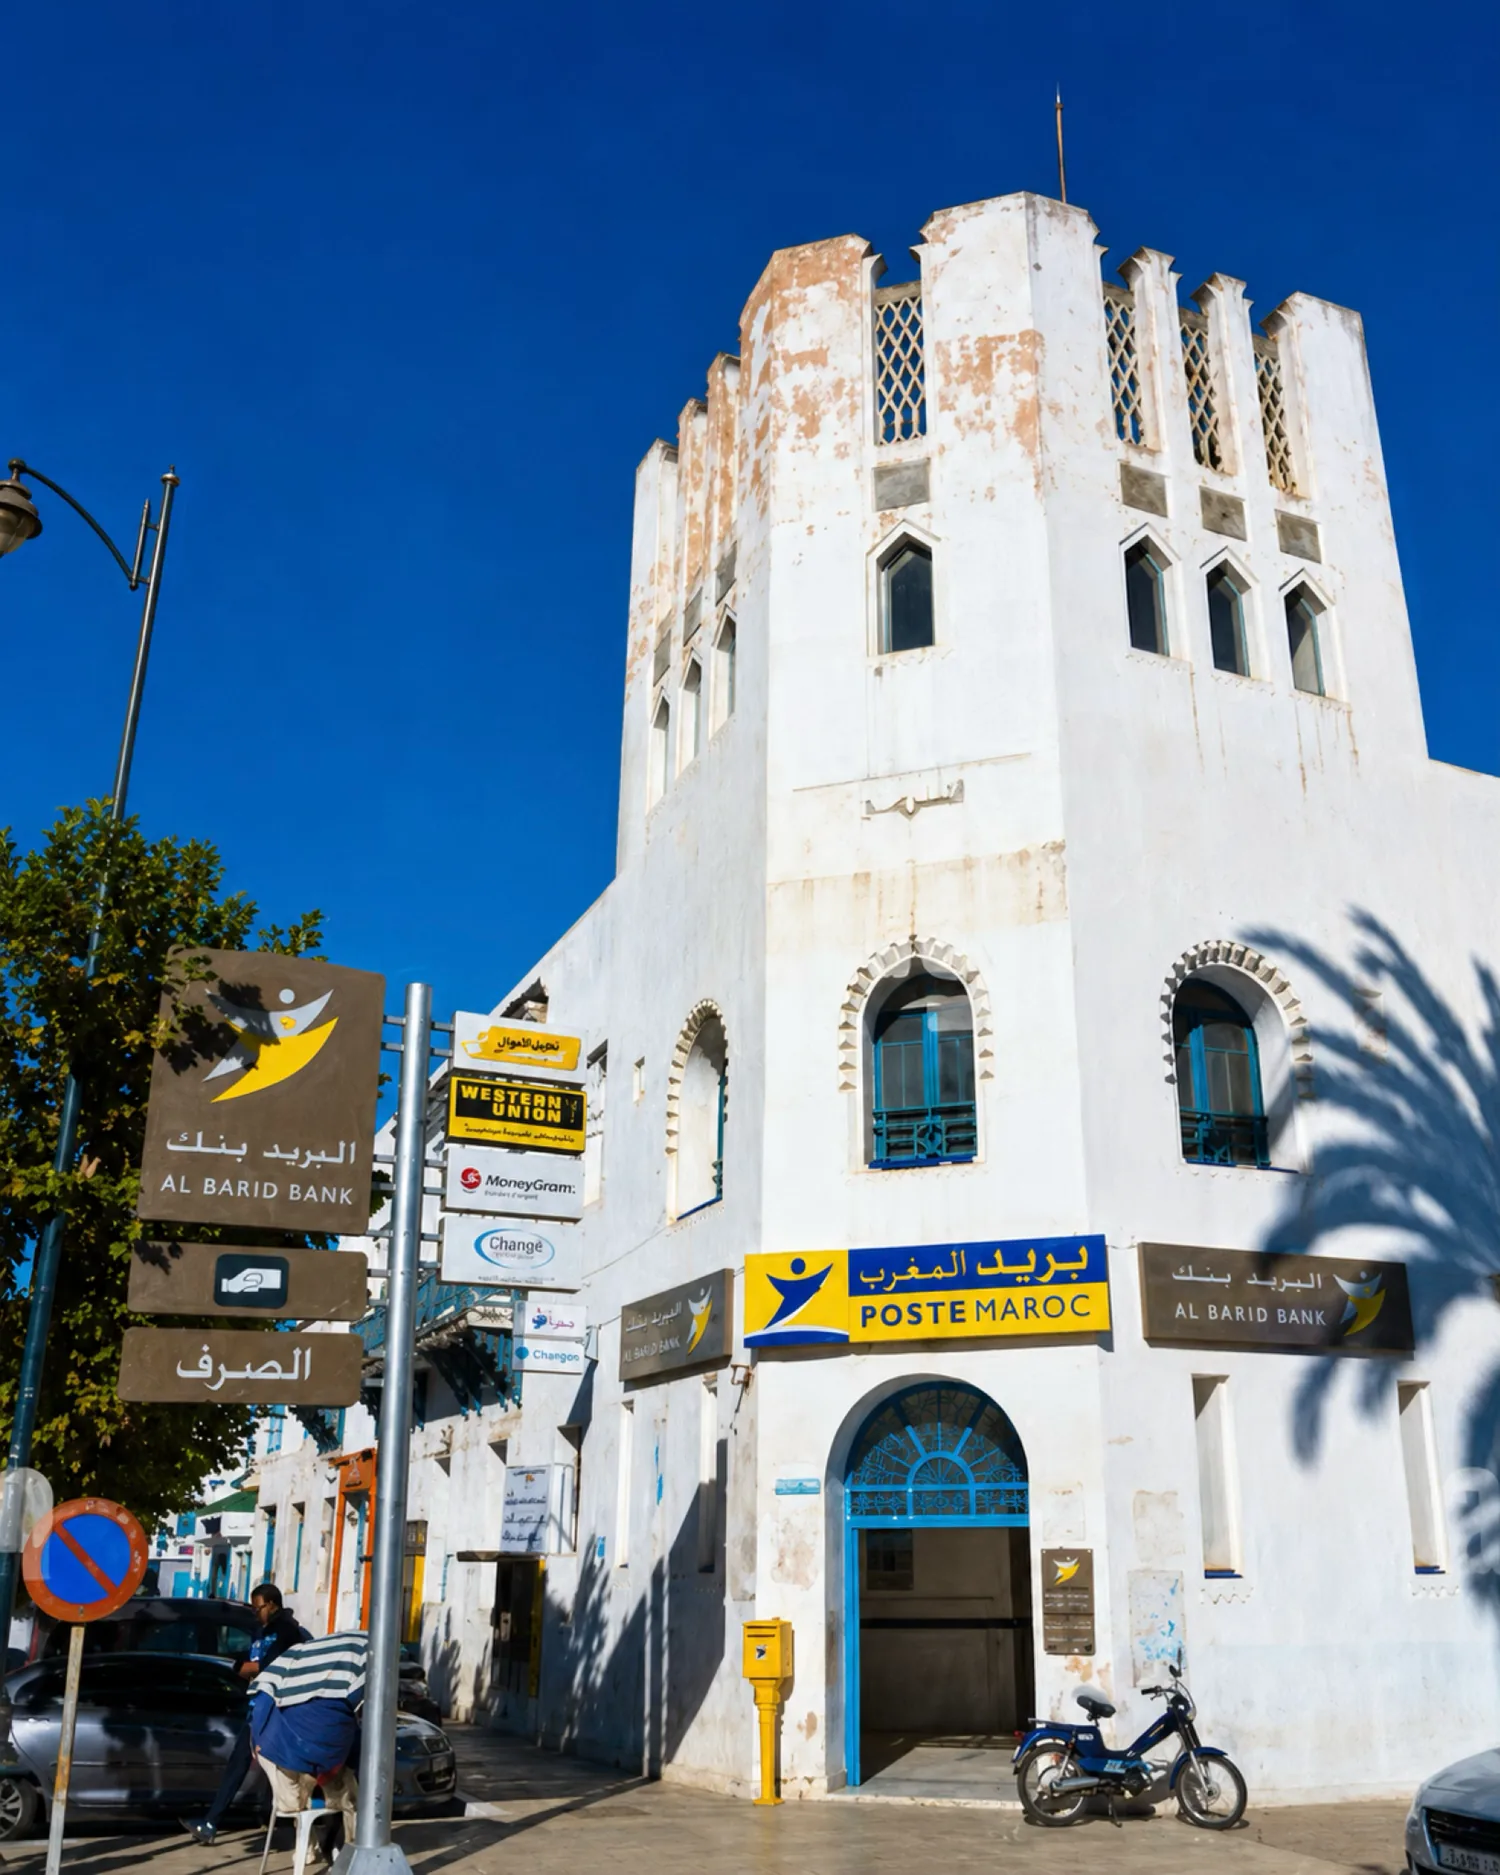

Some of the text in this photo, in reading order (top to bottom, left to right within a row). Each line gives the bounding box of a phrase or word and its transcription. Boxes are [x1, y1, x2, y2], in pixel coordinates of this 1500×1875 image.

[461, 1085, 561, 1109] WESTERN
[492, 1103, 561, 1123] UNION
[166, 1131, 356, 1169] البريد بنك
[160, 1174, 353, 1205] AL BARID BANK
[859, 1245, 1089, 1292] بريد المغرب
[1172, 1265, 1322, 1292] البريد بنك
[626, 1301, 682, 1332] البريد بنك
[861, 1294, 1090, 1328] POSTE MAROC
[1175, 1302, 1327, 1326] AL BARID BANK
[176, 1344, 311, 1391] الصرف
